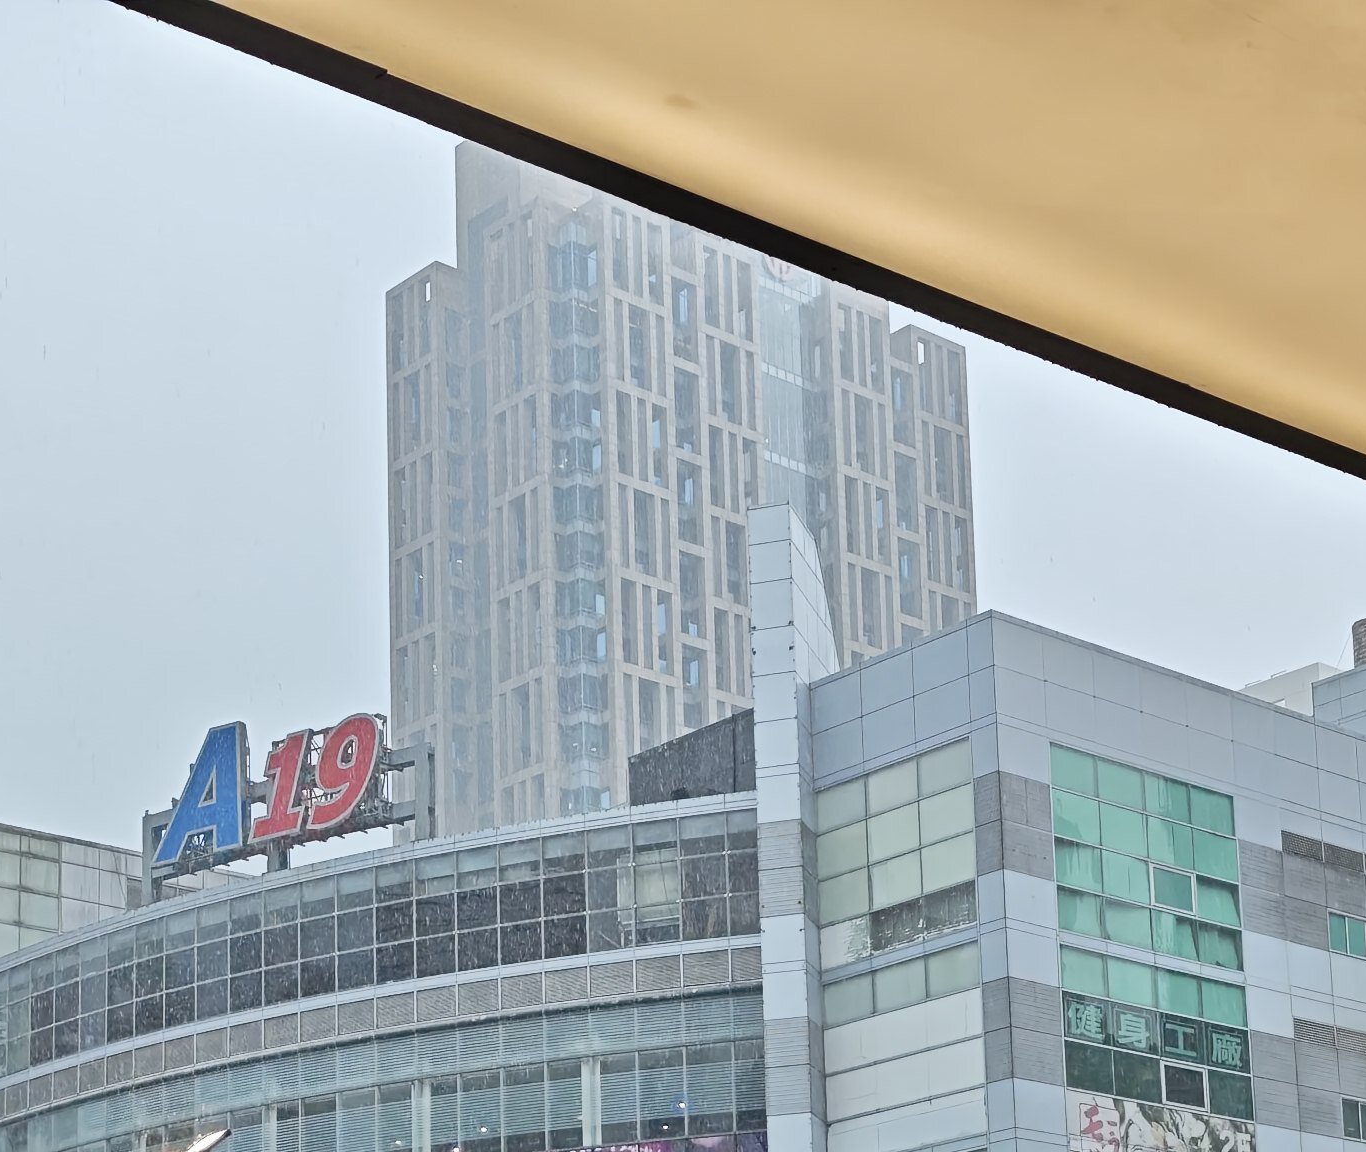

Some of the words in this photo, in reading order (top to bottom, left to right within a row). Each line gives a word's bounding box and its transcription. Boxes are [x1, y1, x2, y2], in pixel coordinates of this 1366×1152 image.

[151, 712, 382, 867] A19
[1068, 1002, 1243, 1068] 健身工廠
